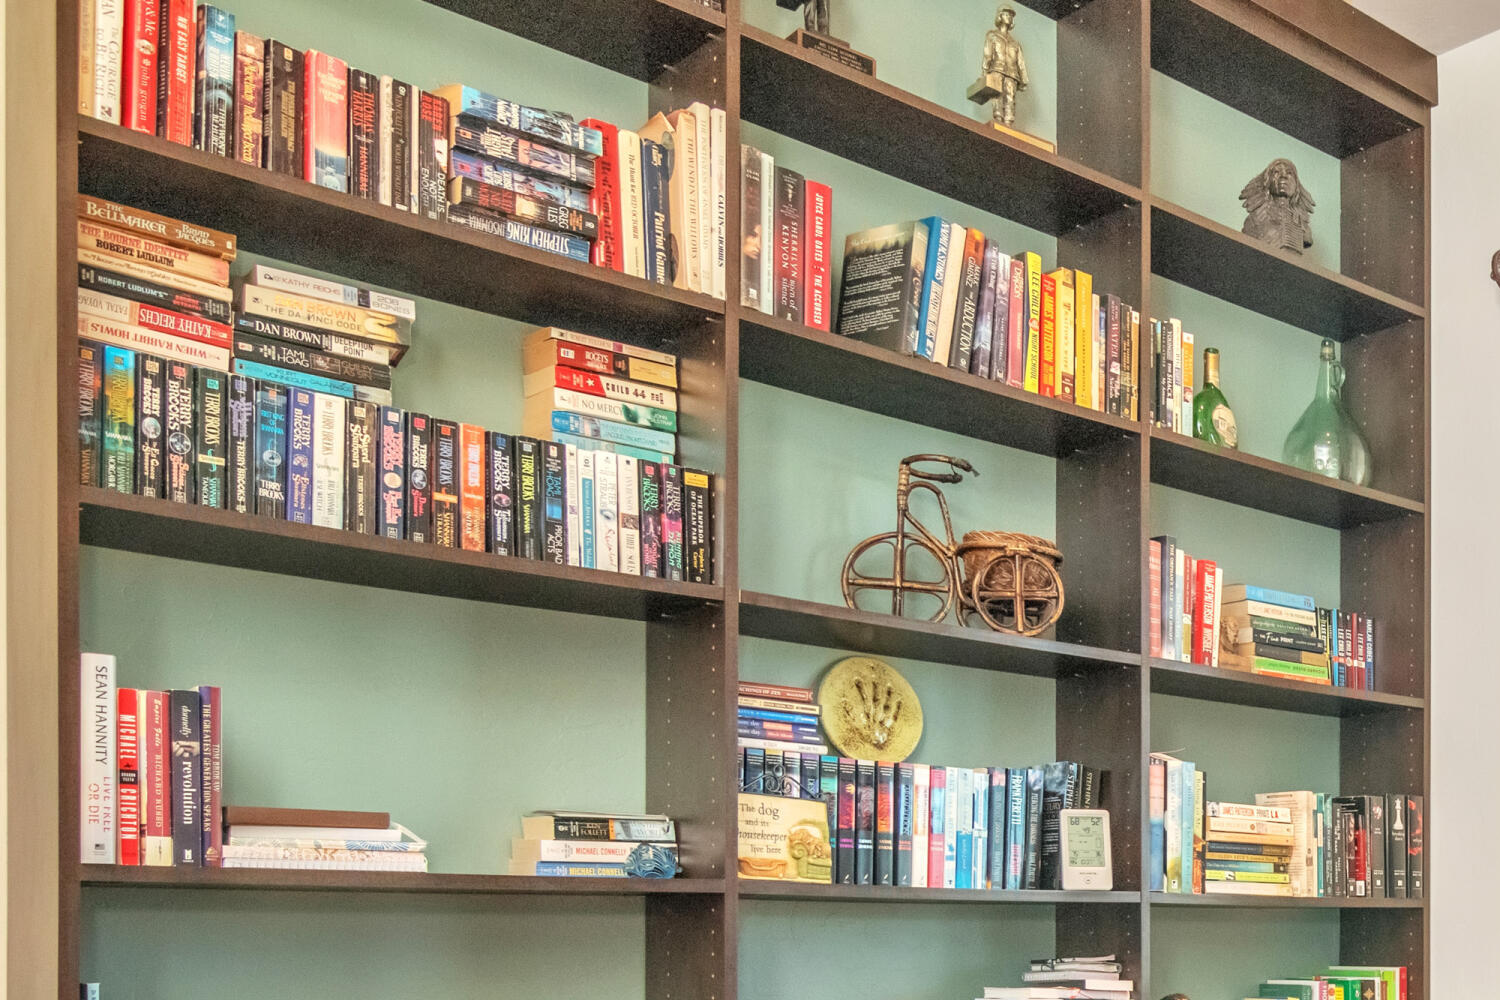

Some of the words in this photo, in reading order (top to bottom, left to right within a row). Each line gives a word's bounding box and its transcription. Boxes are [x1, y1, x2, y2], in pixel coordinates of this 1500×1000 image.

[177, 30, 187, 50] EASY
[141, 66, 150, 86] john
[176, 53, 187, 83] TARGET
[353, 91, 363, 126] HARRIS
[365, 92, 374, 132] THOMAS
[422, 95, 432, 121] ROSE
[359, 146, 368, 192] HANNIBAL
[437, 173, 445, 202] DEATH
[106, 203, 123, 212] THE
[438, 204, 444, 212] IS
[547, 206, 558, 223] ILES
[815, 193, 823, 213] JOYCE
[86, 201, 167, 234] BELLMAKER
[558, 206, 569, 229] GREG
[815, 216, 823, 237] CAROL
[80, 224, 100, 235] THE
[104, 229, 141, 247] BOURNE
[144, 240, 189, 261] IDENTITY
[507, 222, 530, 242] KING
[532, 231, 569, 254] STEPHEN
[654, 212, 665, 249] Patriot
[96, 239, 134, 258] ROBERT
[137, 250, 175, 267] LUDLUM
[790, 222, 798, 279] SHERRILYN
[815, 240, 823, 261] OATES
[1032, 271, 1040, 286] LEE
[814, 289, 823, 324] ACCURSED
[1032, 289, 1040, 315] CHILD
[1044, 292, 1053, 318] JAMES
[91, 322, 130, 340] HOWLS
[140, 309, 175, 329] REICHS
[177, 320, 212, 337] KATHY
[960, 298, 974, 354] ABDUCTION
[134, 334, 173, 349] RABBIT
[255, 320, 280, 335] DAN
[283, 328, 321, 345] BROWN
[334, 337, 373, 351] DECEPTION
[1044, 320, 1053, 362] PATTERSON
[175, 343, 206, 357] WHEN
[277, 354, 310, 368] HOAG
[280, 347, 305, 360] TAMI
[344, 347, 364, 357] POINT
[143, 378, 151, 415] BROOKS
[152, 387, 160, 416] TERRY
[606, 382, 630, 395] CHILD
[632, 388, 646, 399] 44
[168, 380, 180, 430] BROOKS
[180, 388, 191, 428] TERRY
[206, 393, 220, 416] TERRY
[582, 400, 595, 410] NO
[598, 404, 623, 416] MERCY
[206, 417, 220, 445] BROOKS
[293, 408, 303, 449] BROOKS
[303, 414, 311, 448] TERRY
[440, 438, 452, 457] TERRY
[440, 459, 452, 485] BROOKS
[494, 450, 502, 491] BROOKS
[502, 456, 510, 490] TERRY
[521, 455, 534, 474] TERRY
[523, 475, 534, 500] BROOKS
[546, 471, 554, 496] HOAG
[553, 476, 561, 496] TAMI
[691, 491, 696, 500] OF
[1205, 574, 1214, 593] JAMES
[1203, 593, 1214, 624] PATTERSON
[96, 666, 107, 699] SEAN
[180, 706, 191, 737] donnelly
[96, 705, 107, 765] HANNITY
[119, 714, 136, 759] MICHAEL
[89, 784, 98, 801] OR
[182, 761, 196, 824] revolution
[1012, 776, 1023, 798] FRANK
[89, 806, 99, 824] DIE
[120, 788, 137, 840] CRICHTON
[740, 803, 755, 812] The
[758, 803, 780, 820] dog
[1012, 799, 1022, 825] PERETTI
[750, 845, 764, 854] live
